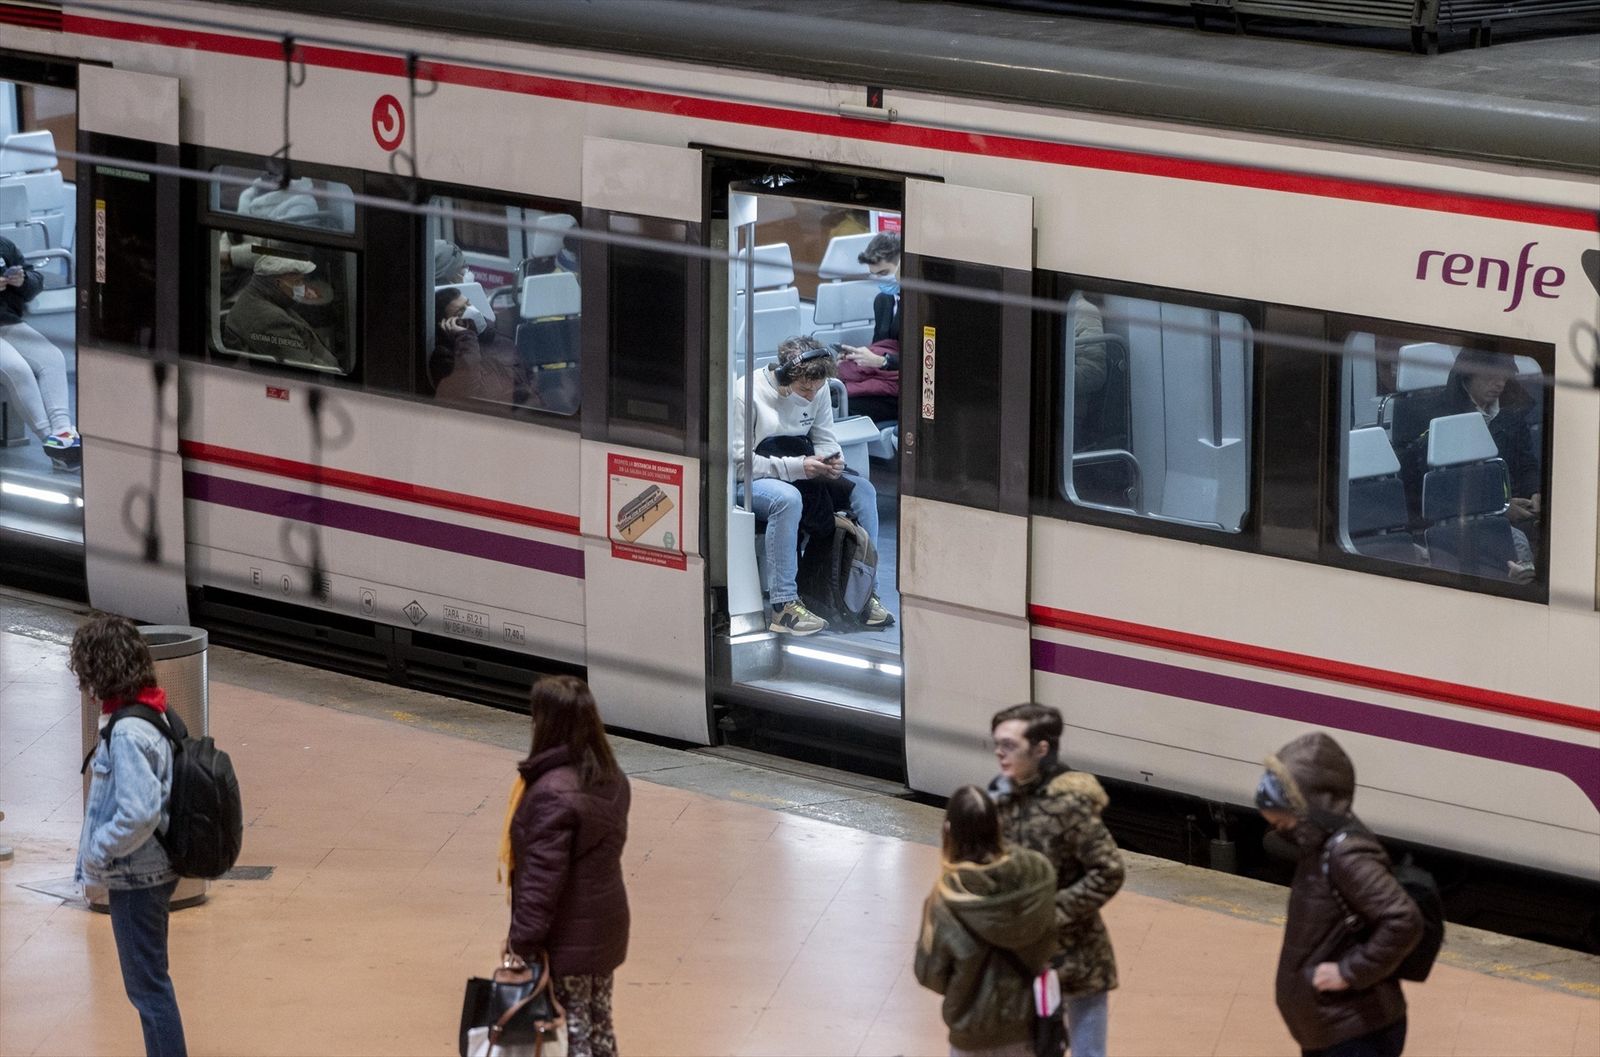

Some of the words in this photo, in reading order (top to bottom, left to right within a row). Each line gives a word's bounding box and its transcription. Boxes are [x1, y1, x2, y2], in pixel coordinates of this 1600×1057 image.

[1416, 241, 1566, 312] renfe
[271, 335, 278, 345] DE
[278, 337, 305, 349] EMERGENC
[633, 461, 652, 470] DISTANCIA
[657, 465, 678, 474] SEGURIDAD
[253, 571, 260, 585] E
[283, 578, 289, 591] D
[444, 607, 460, 620] TARA
